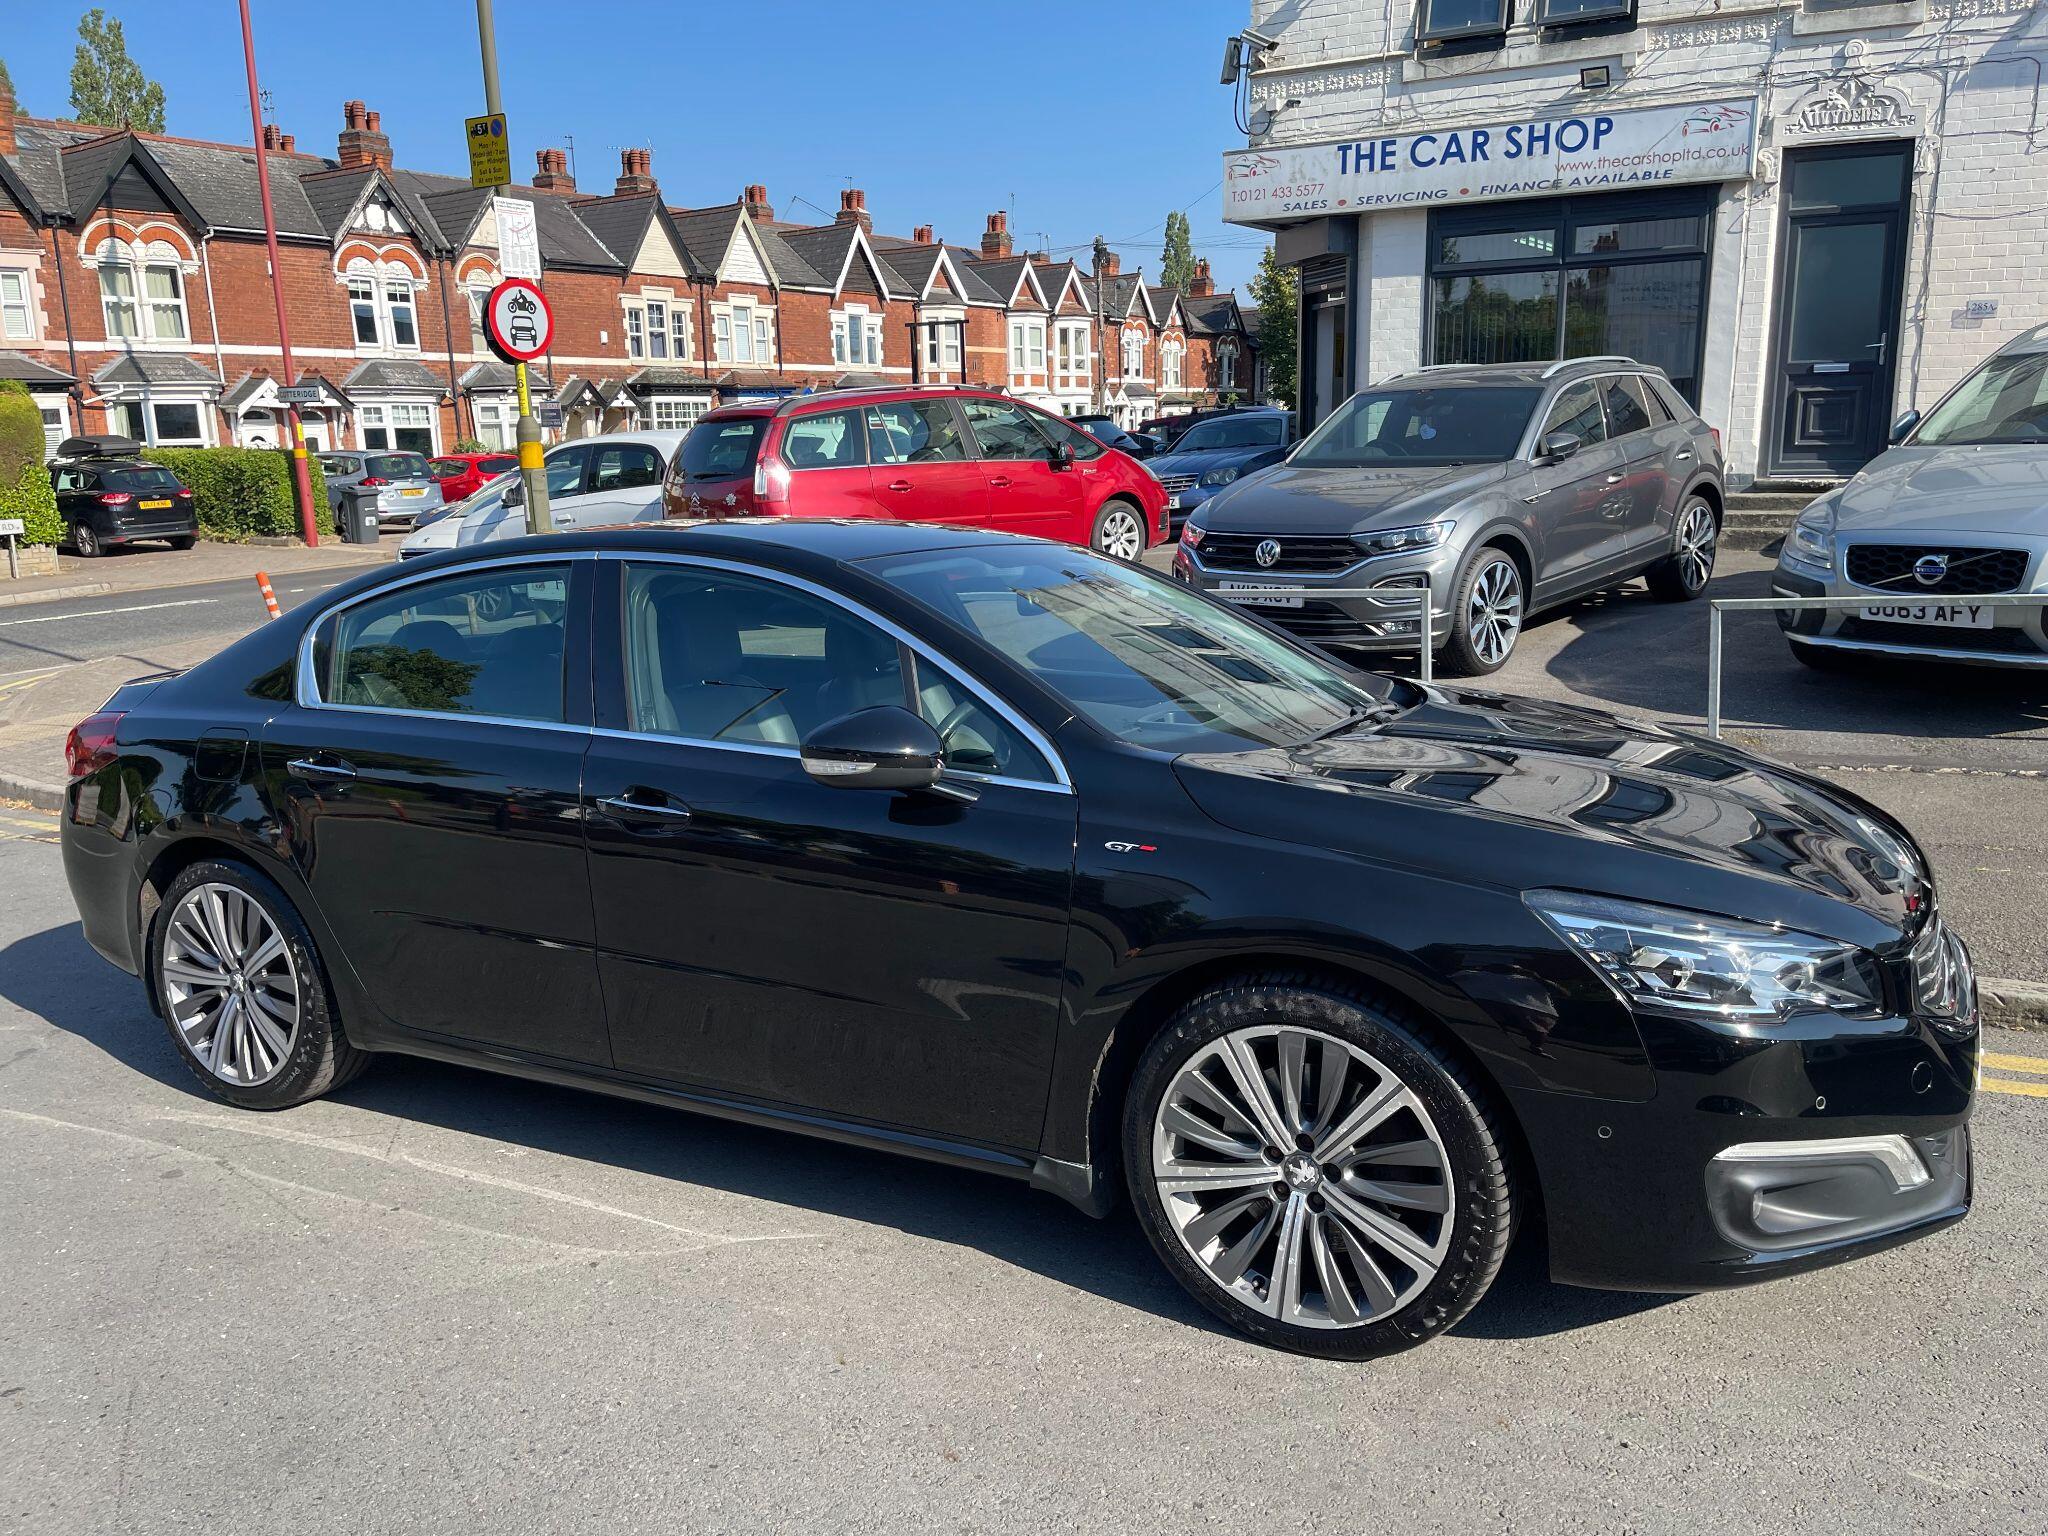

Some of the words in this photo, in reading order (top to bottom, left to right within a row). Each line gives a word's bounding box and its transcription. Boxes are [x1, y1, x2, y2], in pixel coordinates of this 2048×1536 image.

[1337, 139, 1398, 175] THE
[1409, 130, 1490, 168] CAR
[1503, 117, 1614, 159] SHOP
[1555, 143, 1750, 173] www.thecarshopltd.co.uk
[1232, 188, 1267, 203] T:0121
[1272, 185, 1293, 199] 433
[1296, 183, 1325, 197] 5577
[1283, 199, 1328, 212] SALES
[1356, 189, 1449, 206] SERVICING
[1479, 178, 1563, 195] FINANCE
[1568, 168, 1675, 187] AVAILABLE
[1934, 606, 1981, 623] AFY
[1104, 841, 1141, 853] GT
